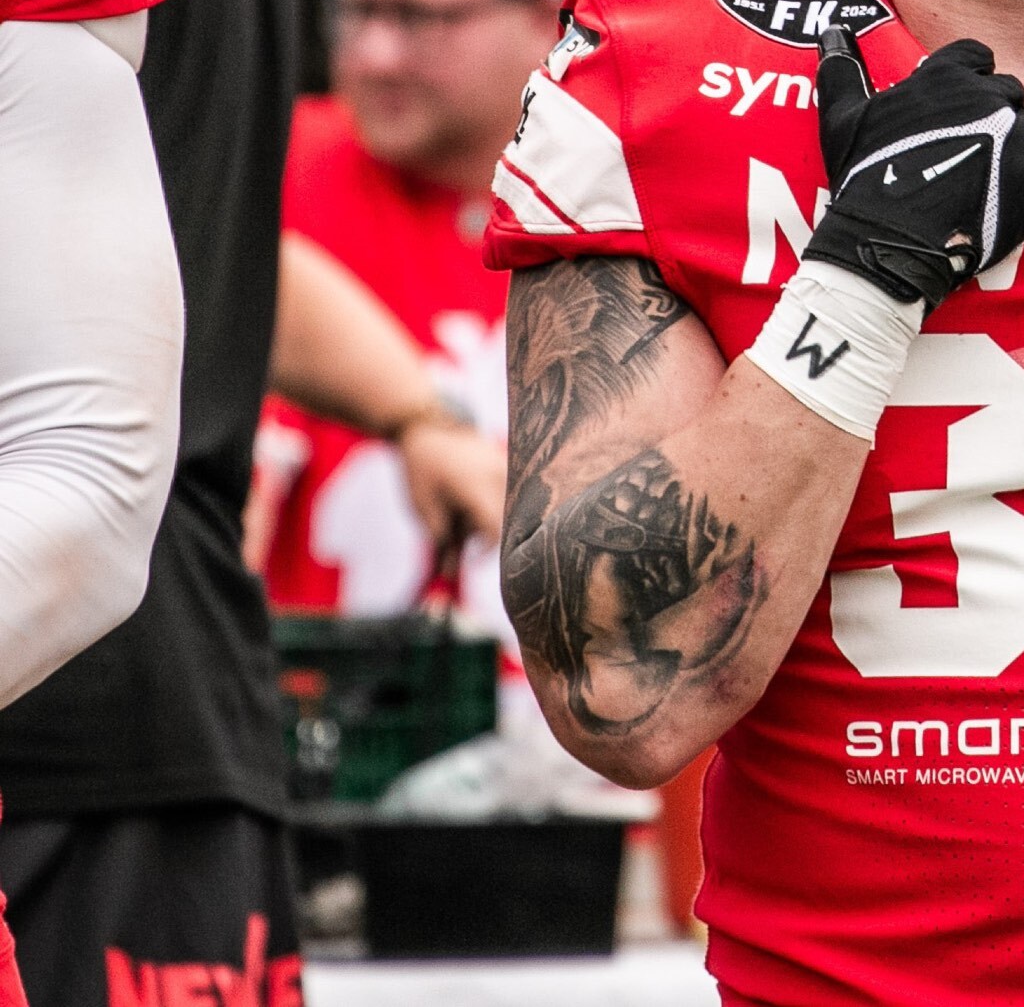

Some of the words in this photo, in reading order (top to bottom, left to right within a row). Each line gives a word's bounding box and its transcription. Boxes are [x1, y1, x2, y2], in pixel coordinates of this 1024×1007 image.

[840, 5, 878, 18] 2024
[698, 62, 819, 116] syn
[846, 768, 908, 786] SMART
